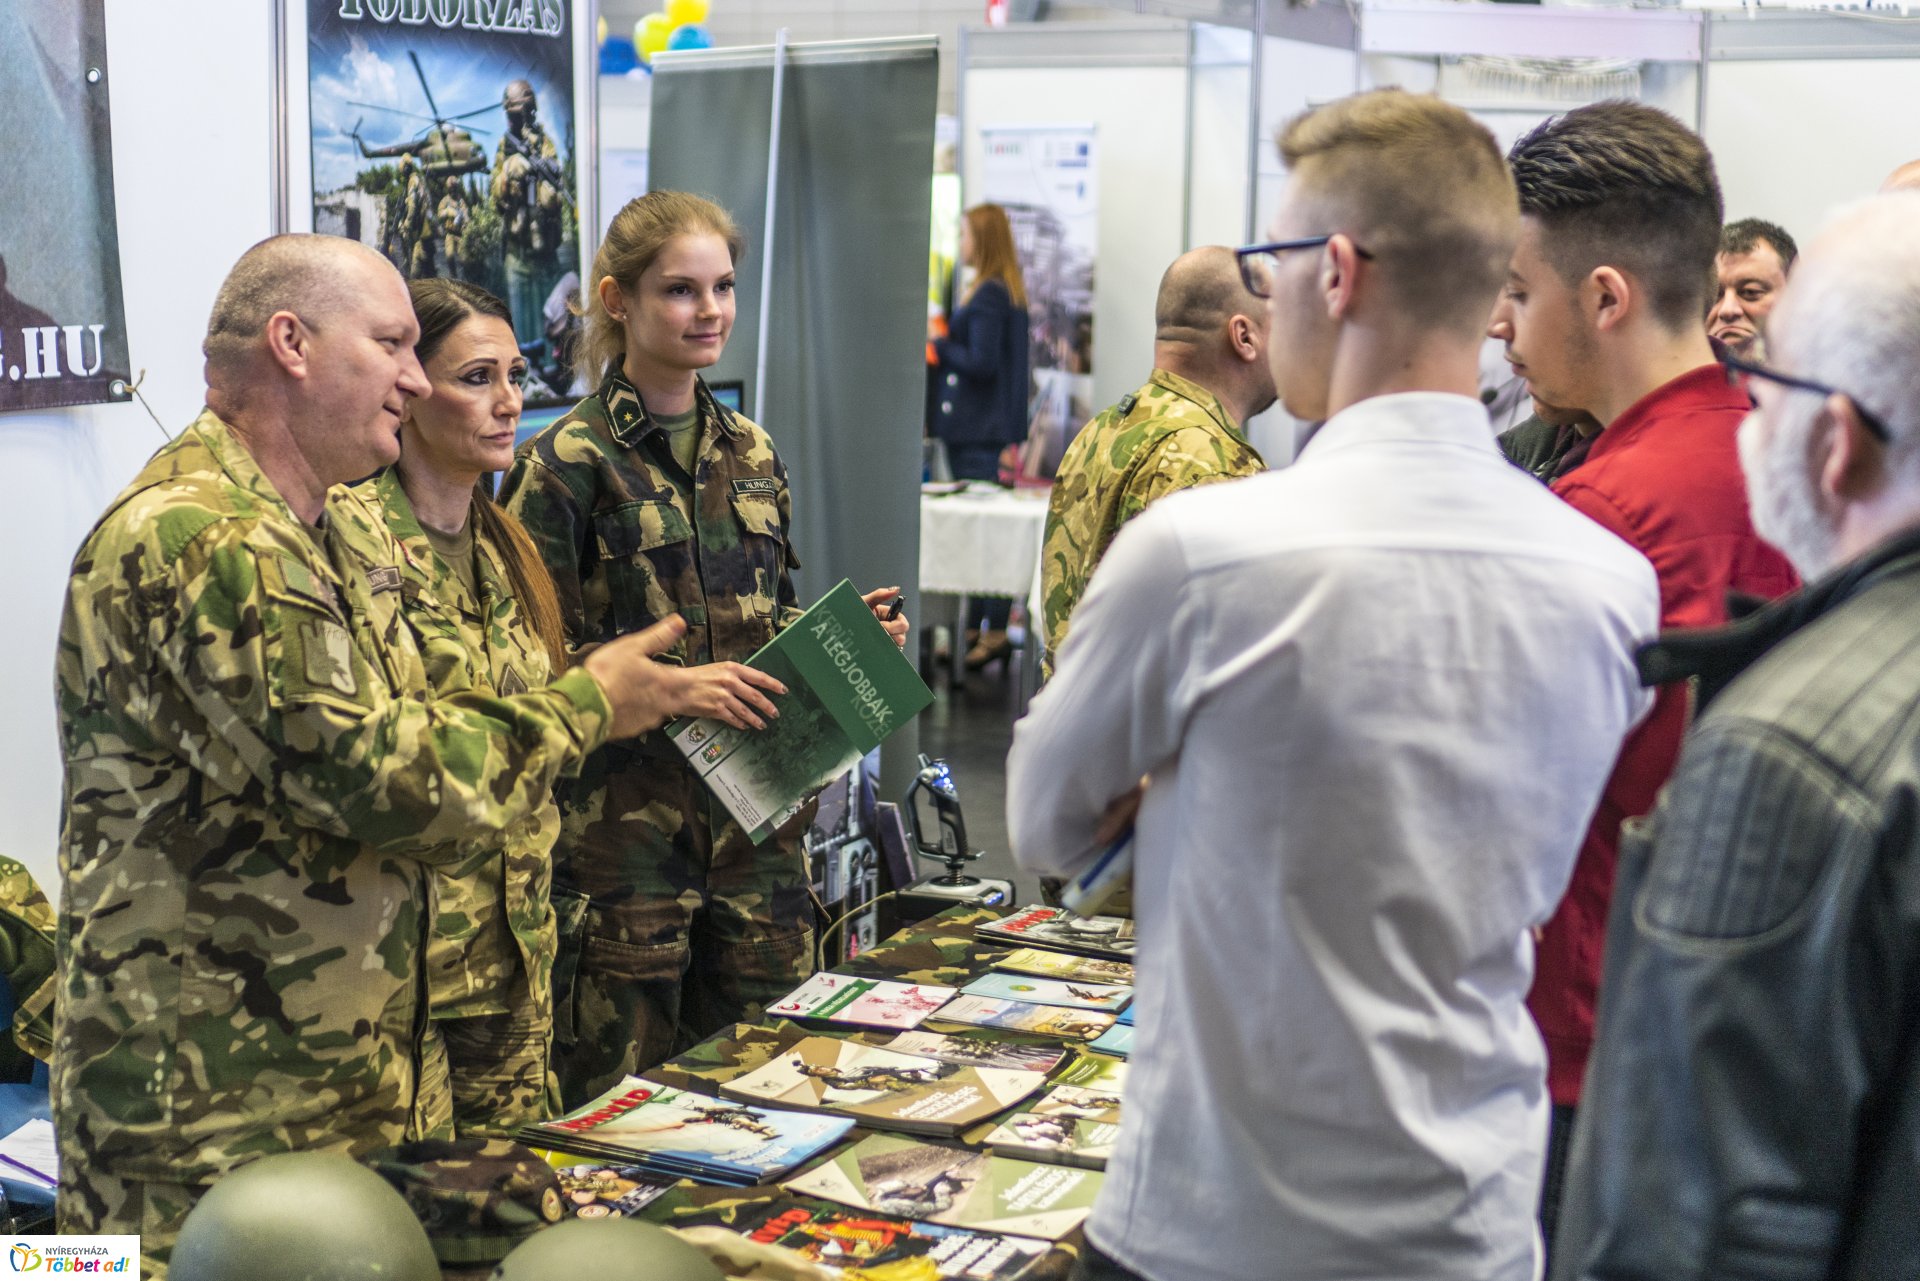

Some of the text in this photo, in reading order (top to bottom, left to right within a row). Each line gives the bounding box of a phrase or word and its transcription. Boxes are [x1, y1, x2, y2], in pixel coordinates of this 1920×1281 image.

[0, 324, 104, 381] .HU
[810, 622, 894, 724] A LEGJOBBAK
